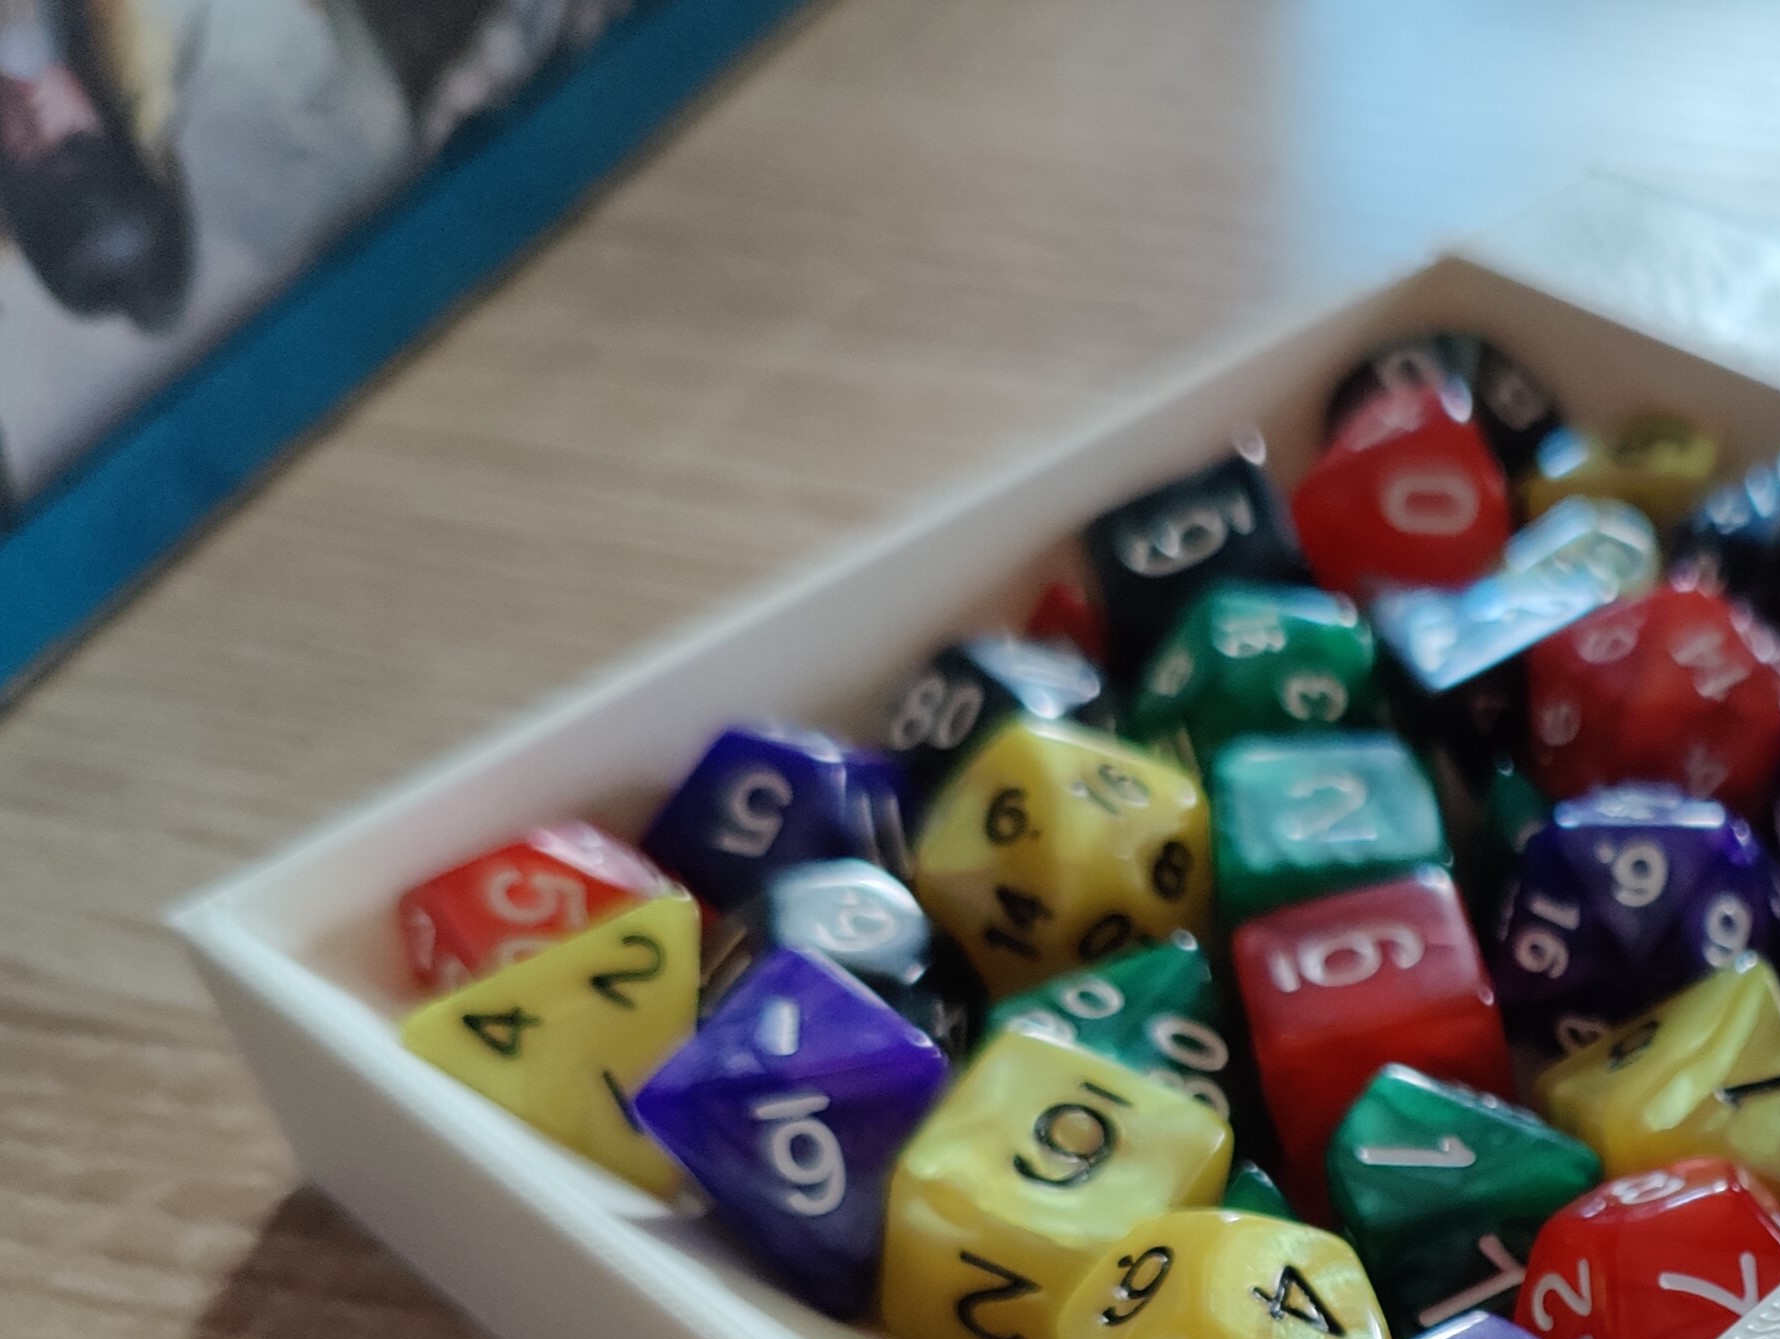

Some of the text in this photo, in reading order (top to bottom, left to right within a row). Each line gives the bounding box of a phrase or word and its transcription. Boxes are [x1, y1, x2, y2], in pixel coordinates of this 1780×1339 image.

[1286, 772, 1379, 843] 2
[1151, 837, 1194, 902] 8
[589, 934, 666, 1012] 2
[461, 1004, 543, 1058] 4
[1352, 1135, 1477, 1168] 1
[1251, 1264, 1347, 1338] 4
